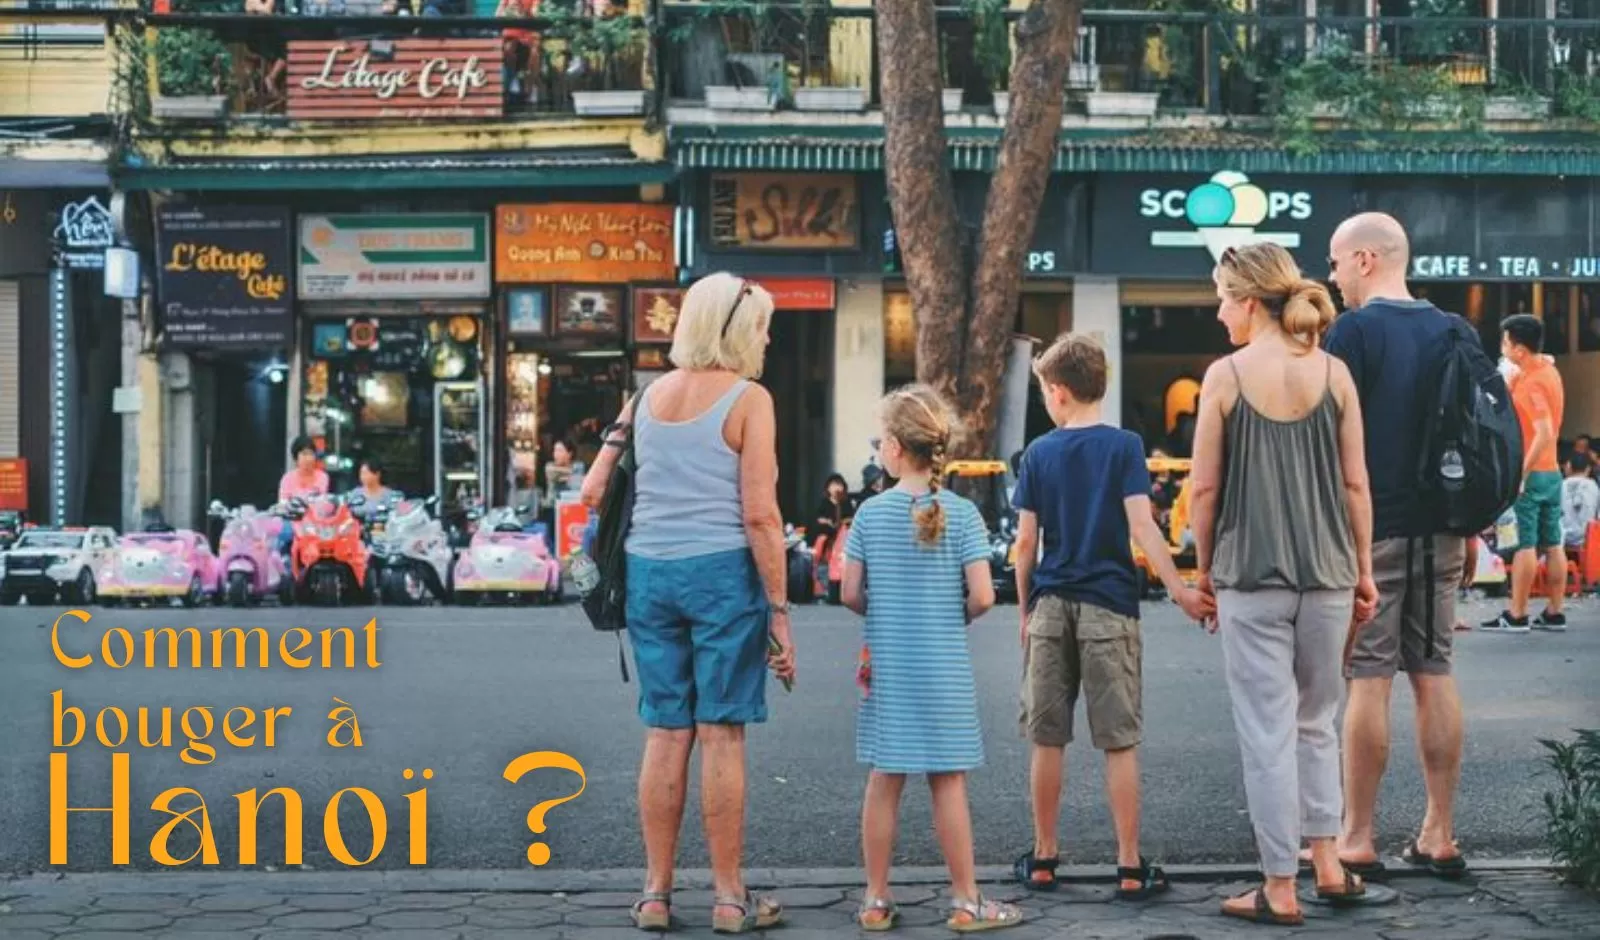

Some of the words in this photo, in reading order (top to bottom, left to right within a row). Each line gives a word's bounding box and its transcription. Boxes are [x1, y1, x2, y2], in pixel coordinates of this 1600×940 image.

[1027, 252, 1055, 271] PS
[1414, 255, 1470, 277] CAFE
[1498, 256, 1540, 277] TEA
